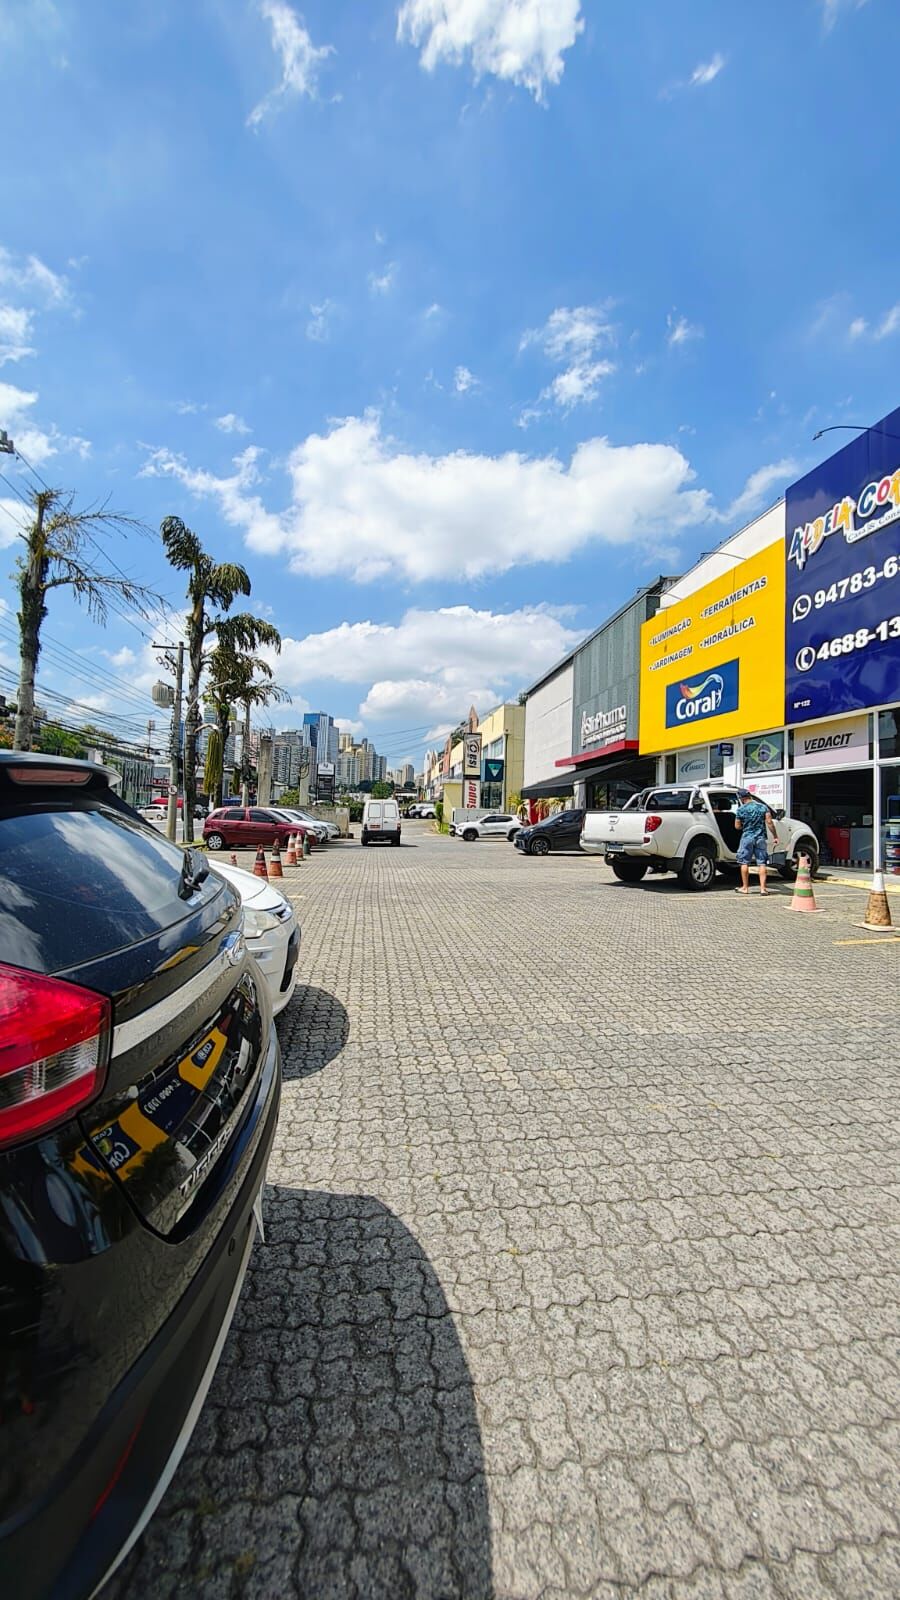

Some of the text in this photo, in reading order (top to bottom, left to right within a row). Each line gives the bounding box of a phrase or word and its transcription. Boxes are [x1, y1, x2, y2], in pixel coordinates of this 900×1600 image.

[788, 496, 855, 570] ALDEIA
[704, 577, 767, 617] FERRAMENTAS
[814, 554, 900, 609] 94783-6
[653, 645, 693, 671] JARDINAGEM
[676, 690, 716, 720] Coral
[804, 733, 853, 751] VEDACIT
